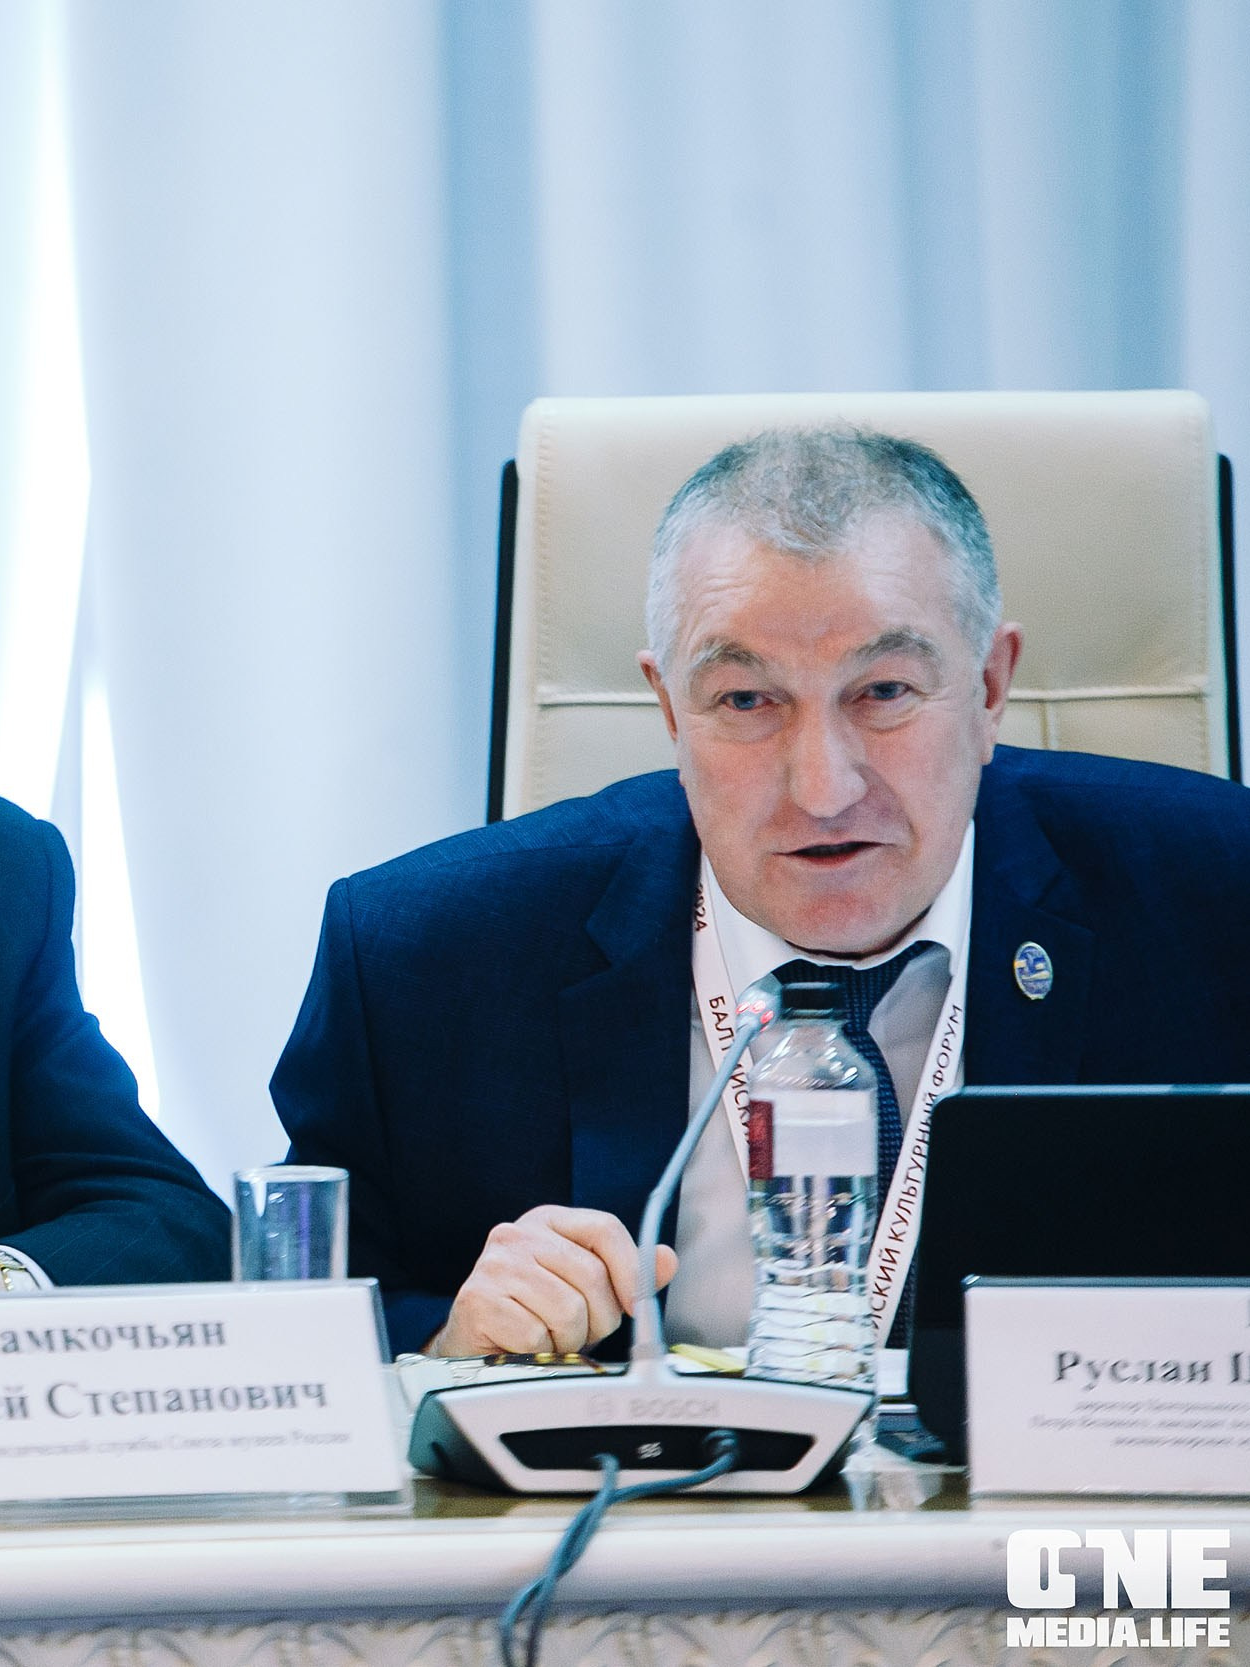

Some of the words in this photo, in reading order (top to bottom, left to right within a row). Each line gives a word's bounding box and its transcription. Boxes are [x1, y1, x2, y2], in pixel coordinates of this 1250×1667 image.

[932, 1004, 963, 1087] ФОРУМ
[1054, 1350, 1213, 1392] Руслан
[44, 1381, 327, 1420] Степанович
